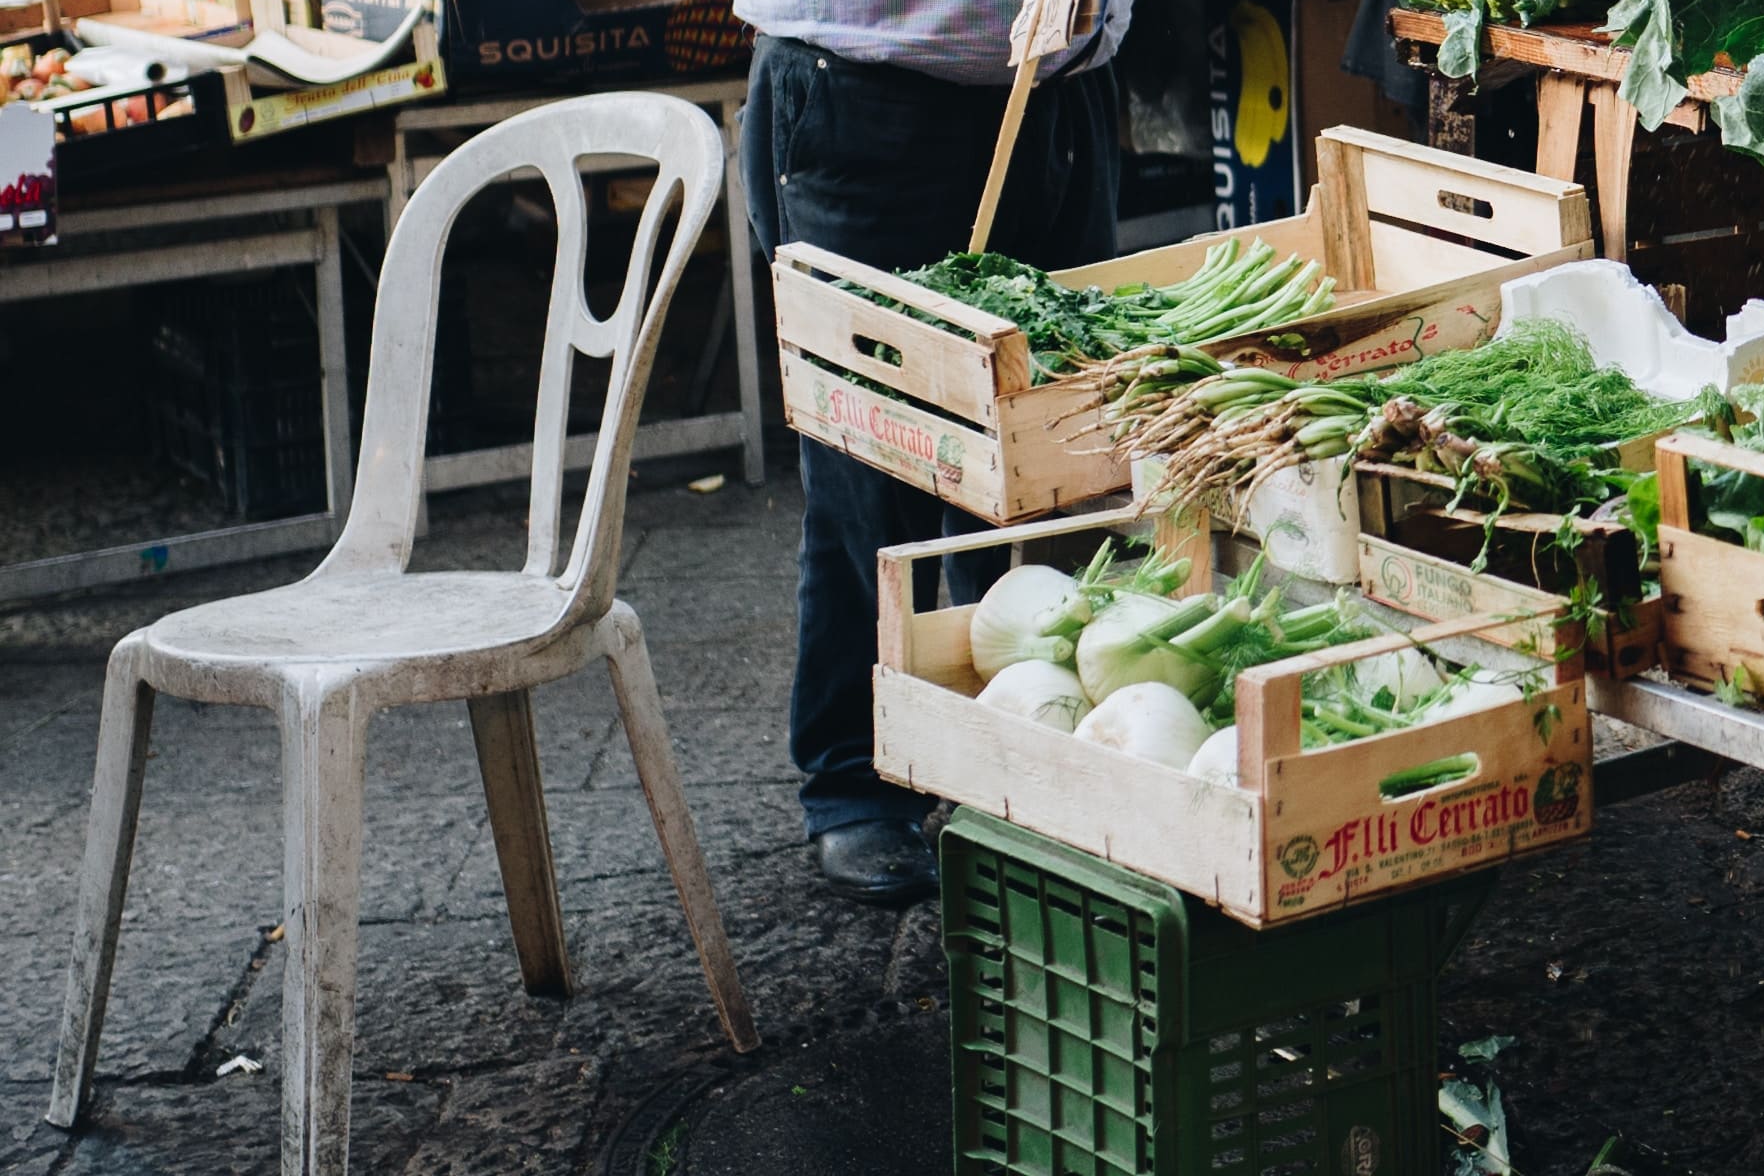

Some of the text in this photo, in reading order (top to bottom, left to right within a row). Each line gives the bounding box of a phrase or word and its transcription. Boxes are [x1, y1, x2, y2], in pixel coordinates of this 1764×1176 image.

[478, 26, 650, 65] SQUISITA
[1208, 25, 1236, 233] QUISITA
[1308, 339, 1414, 377] errato
[830, 388, 867, 433] F.lli
[868, 405, 933, 461] Cerrato
[1415, 564, 1473, 597] FUNGO
[1318, 809, 1400, 881] F.lli
[1409, 782, 1530, 846] Cerrato
